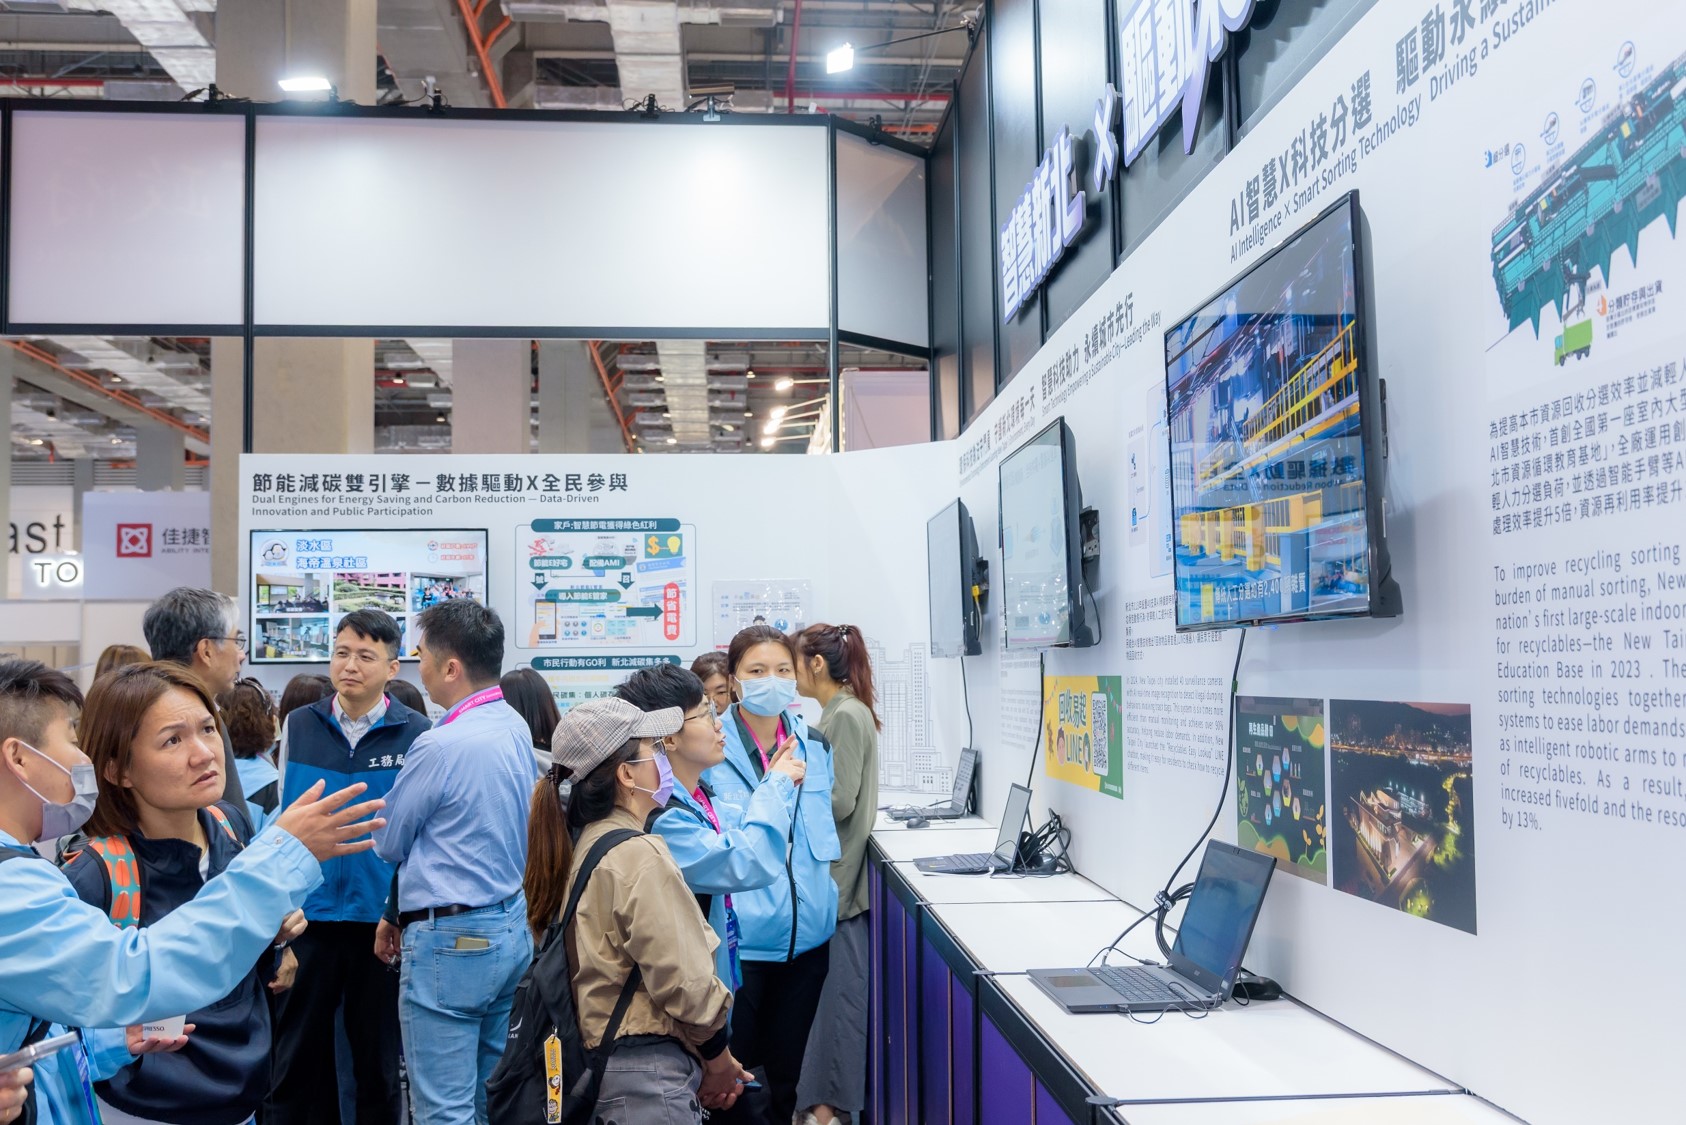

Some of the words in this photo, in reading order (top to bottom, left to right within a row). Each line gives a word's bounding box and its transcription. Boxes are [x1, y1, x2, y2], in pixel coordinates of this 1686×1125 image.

[1230, 243, 1238, 264] AI
[1238, 210, 1282, 257] Intelligence
[1293, 178, 1320, 213] Smart
[1321, 148, 1357, 190] Sorting
[1358, 93, 1422, 160] Technology
[1430, 46, 1478, 102] Driving
[1480, 38, 1489, 60] a
[1492, 0, 1556, 49] Sustain
[1230, 69, 1372, 237] AI智慧X科技分選
[1001, 123, 1086, 325] 智慧新北
[1041, 344, 1079, 401] 智慧科技助力
[1084, 292, 1134, 365] 永續城市先行
[252, 494, 276, 504] Dual
[278, 494, 319, 506] Engines
[321, 494, 336, 504] for
[338, 494, 374, 506] Energy
[377, 494, 411, 506] Saving
[413, 494, 433, 504] and
[435, 494, 471, 504] Carbon
[474, 494, 526, 503] Reduction
[539, 493, 599, 503] Data-Driven
[252, 506, 308, 516] Innovation
[310, 506, 330, 516] and
[332, 506, 365, 516] Public
[367, 506, 433, 518] Participation
[296, 539, 333, 552] 淡水區
[34, 562, 78, 583] TO
[1494, 565, 1505, 582] To
[1513, 561, 1556, 582] improve
[1565, 549, 1621, 576] recycling
[1631, 542, 1680, 566] sorting
[1495, 587, 1531, 606] burden
[1536, 583, 1546, 602] of
[1551, 578, 1594, 600] manual
[1600, 574, 1651, 598] sorting,
[1657, 571, 1686, 590] New
[1543, 608, 1565, 627] first
[1568, 602, 1637, 630] large-scale
[1641, 600, 1686, 621] indoor
[1496, 636, 1510, 654] for
[1623, 631, 1652, 650] New
[1663, 628, 1686, 649] Tai
[543, 658, 607, 668] 市民行動有GO利
[1497, 661, 1549, 679] Education
[1556, 661, 1583, 678] Base
[1591, 660, 1603, 678] in
[1610, 660, 1641, 678] 2023
[1498, 686, 1534, 708] sorting
[1542, 686, 1619, 711] technologies
[1629, 687, 1686, 713] together
[1499, 712, 1540, 732] systems
[1543, 713, 1554, 730] to
[1557, 716, 1583, 732] ease
[1587, 713, 1619, 734] labor
[368, 754, 405, 768] 工務局
[1065, 734, 1083, 765] LINE
[1500, 738, 1510, 752] as
[1514, 735, 1571, 760] intelligent
[1575, 740, 1619, 762] robotic
[1624, 748, 1657, 765] arms
[1662, 748, 1676, 767] to
[1500, 758, 1511, 776] of
[1519, 762, 1586, 785] recyclables.
[1597, 769, 1611, 789] As
[1623, 776, 1630, 791] a
[1501, 783, 1551, 807] increased
[1555, 789, 1599, 814] fivefold
[1603, 799, 1626, 819] and
[1631, 800, 1652, 822] the
[1502, 806, 1513, 830] by
[1517, 811, 1542, 831] 13%.
